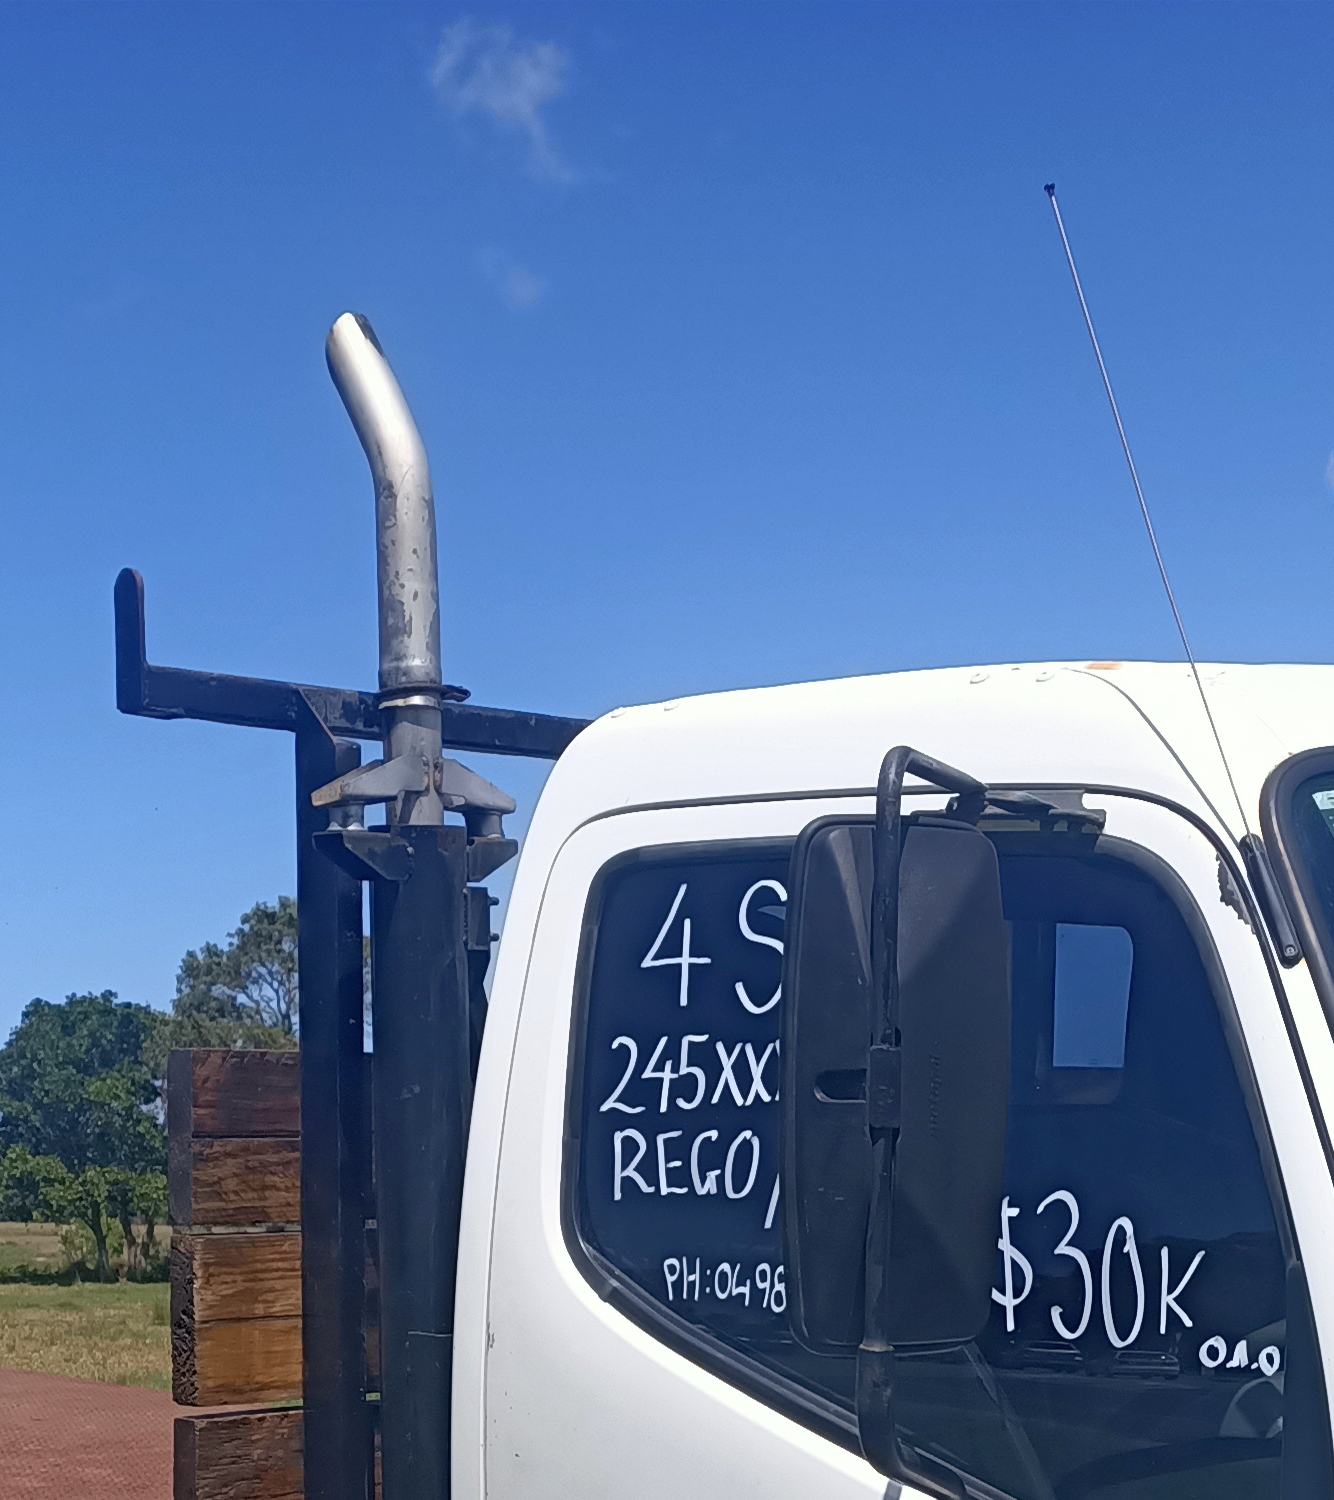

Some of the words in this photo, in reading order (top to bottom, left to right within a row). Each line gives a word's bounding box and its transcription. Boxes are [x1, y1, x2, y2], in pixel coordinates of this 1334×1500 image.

[640, 883, 712, 1007] 4
[599, 1034, 780, 1114] 245XX
[991, 1189, 1206, 1350] $30K
